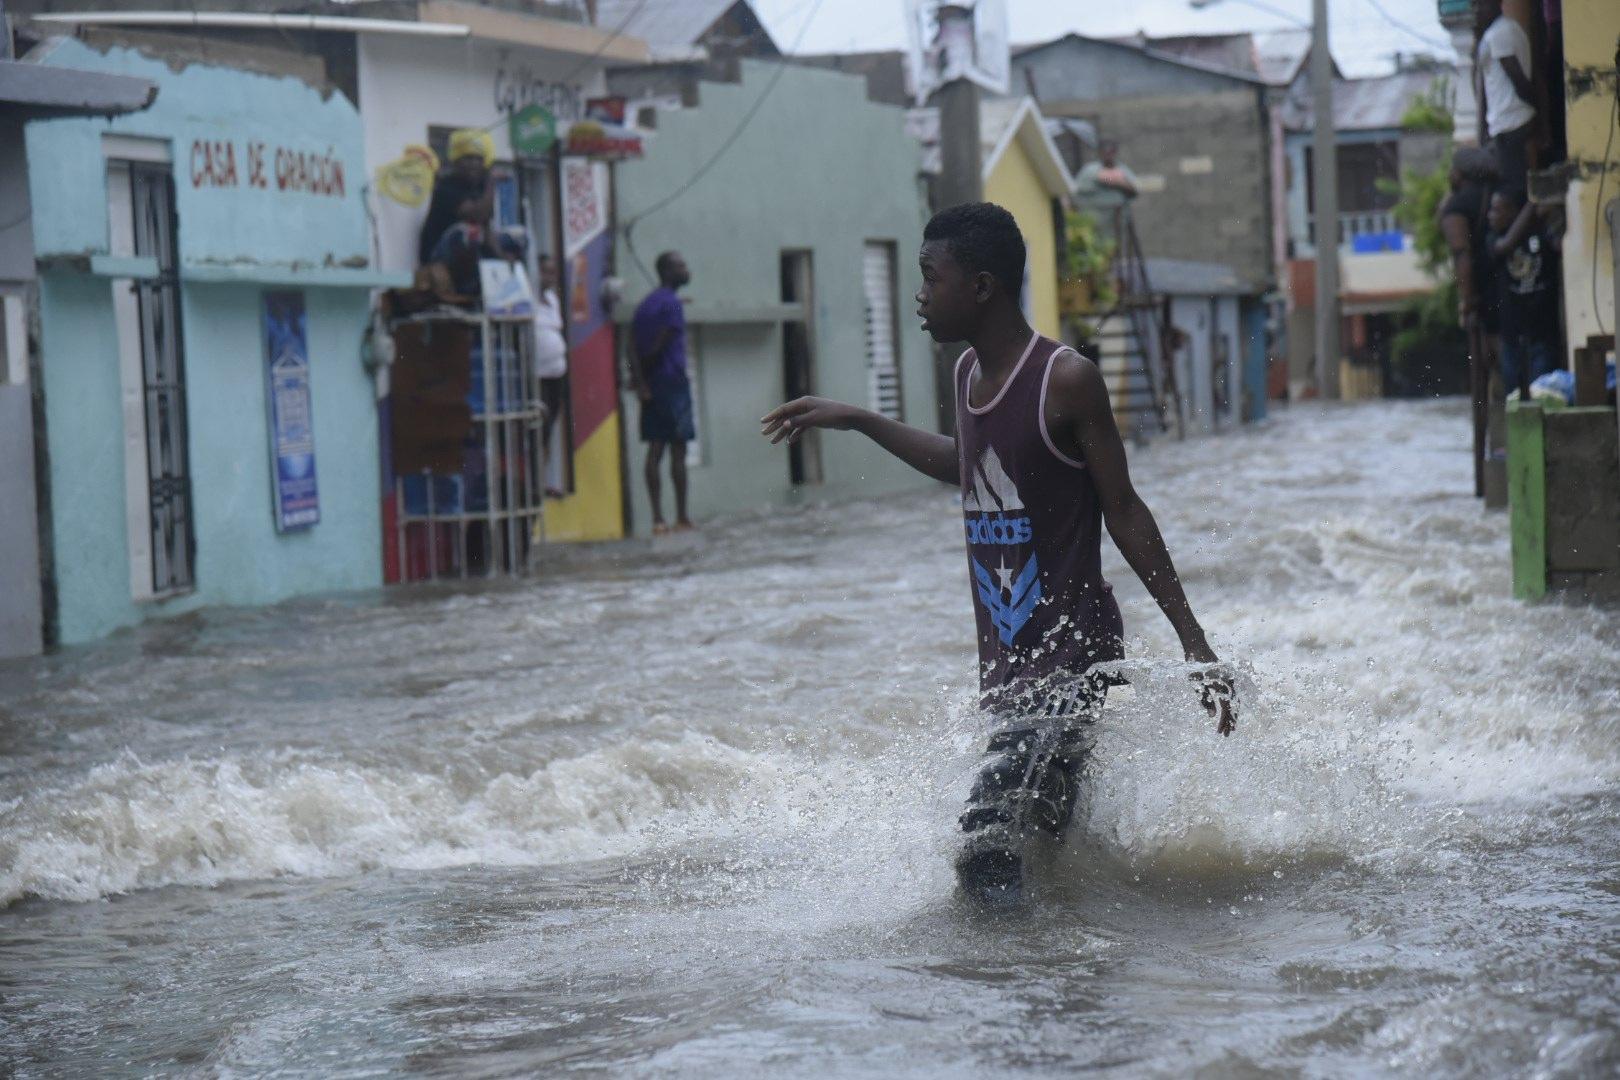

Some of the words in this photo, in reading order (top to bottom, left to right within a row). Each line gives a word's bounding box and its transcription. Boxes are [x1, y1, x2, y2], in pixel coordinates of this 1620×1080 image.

[190, 140, 238, 188] CASA
[248, 141, 267, 189] DE
[965, 511, 1032, 544] adidas
